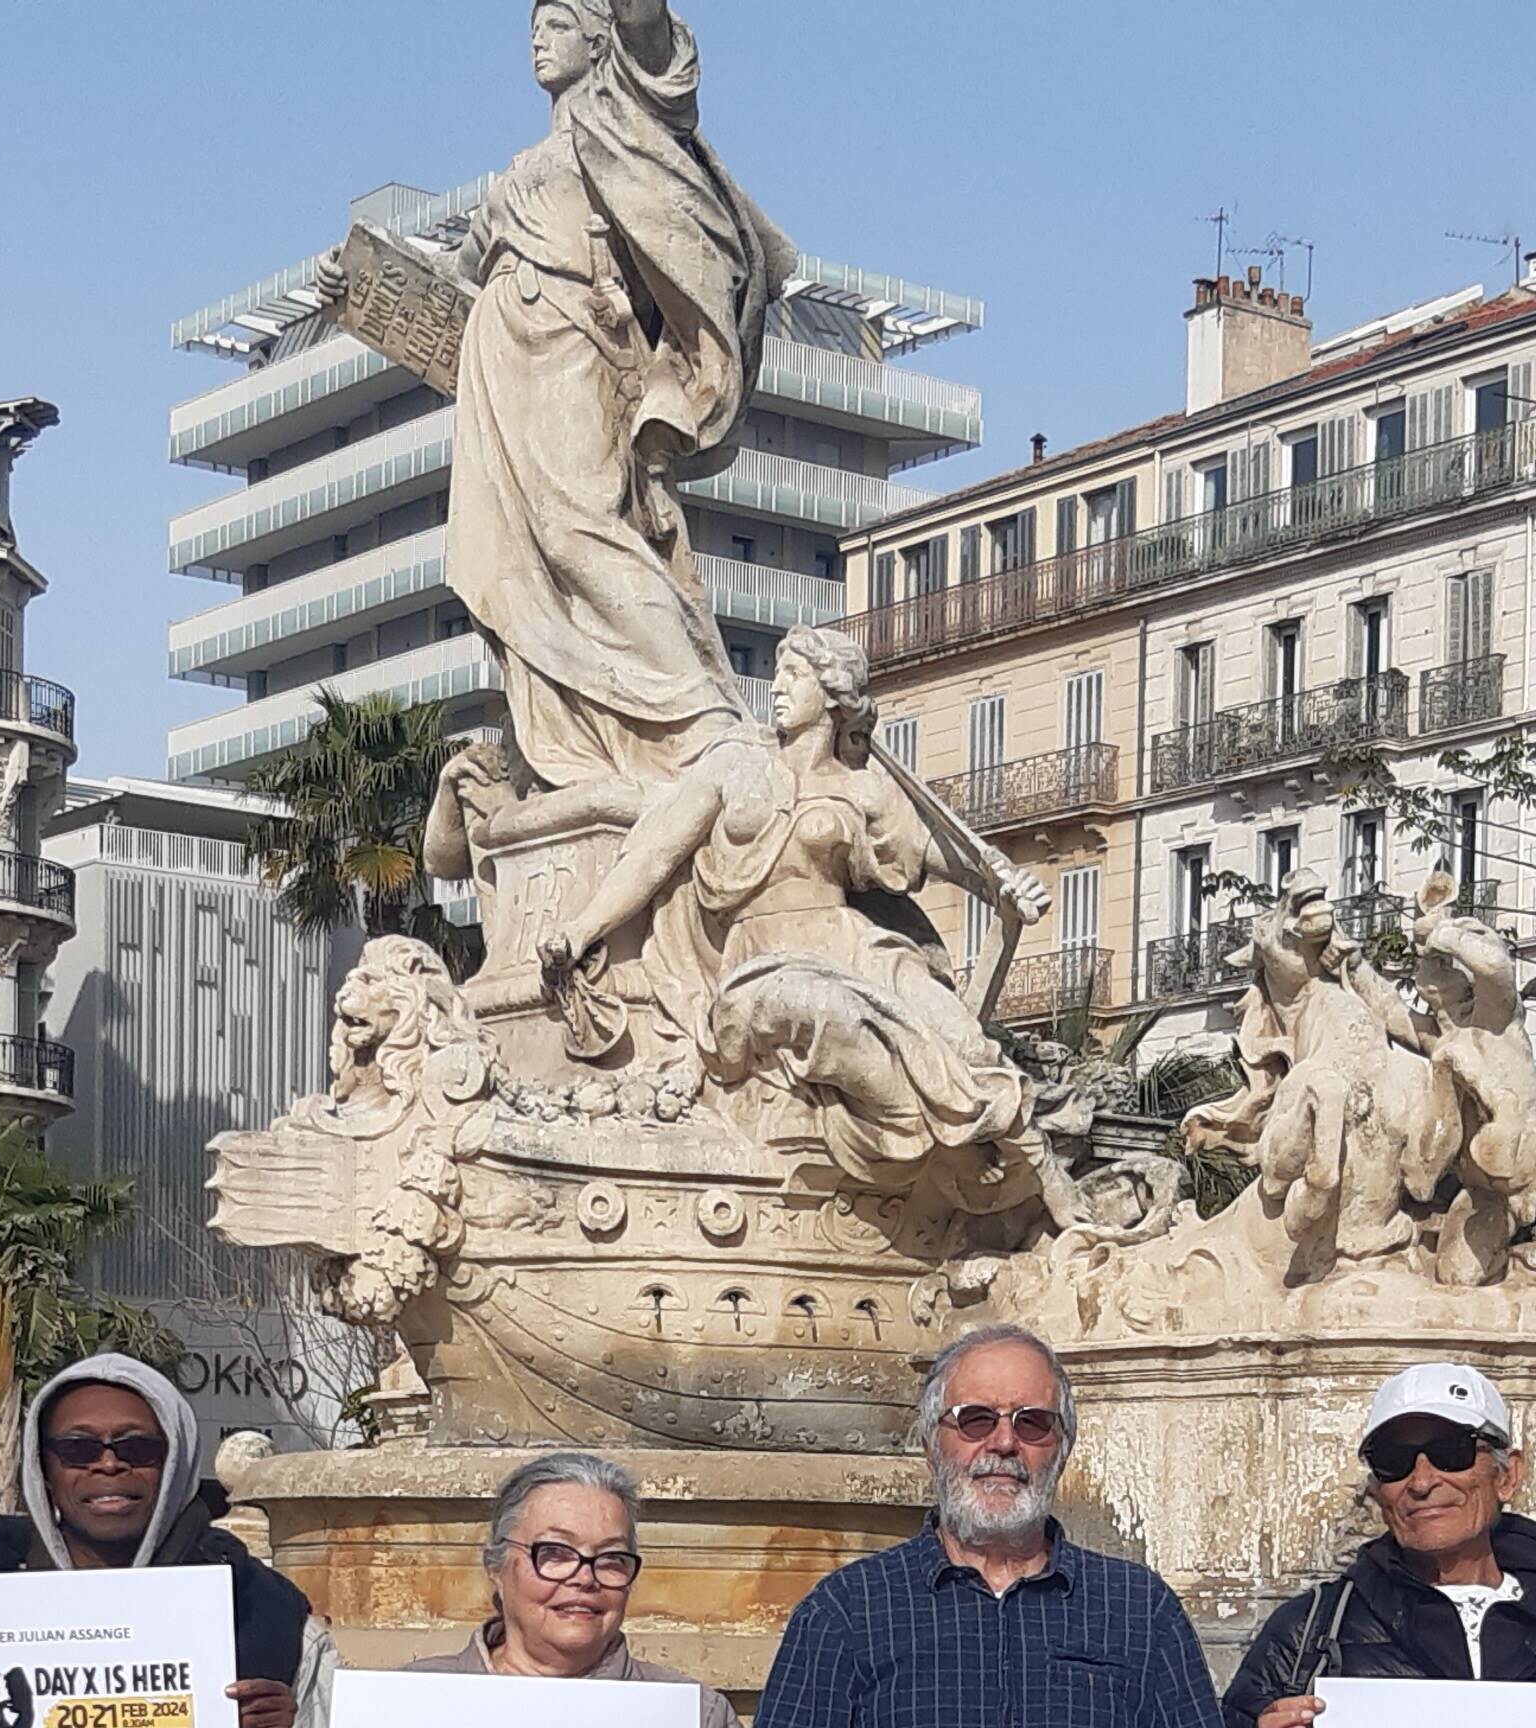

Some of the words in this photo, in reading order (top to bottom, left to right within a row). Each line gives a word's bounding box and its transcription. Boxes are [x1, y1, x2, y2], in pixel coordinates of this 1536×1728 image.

[350, 268, 373, 309] LES
[358, 260, 408, 345] DROITS
[33, 1666, 80, 1697] DAY
[81, 1667, 99, 1695] X
[104, 1665, 127, 1694] IS
[132, 1663, 191, 1693] HERE
[121, 1702, 148, 1718] FEB
[152, 1700, 189, 1717] 2024
